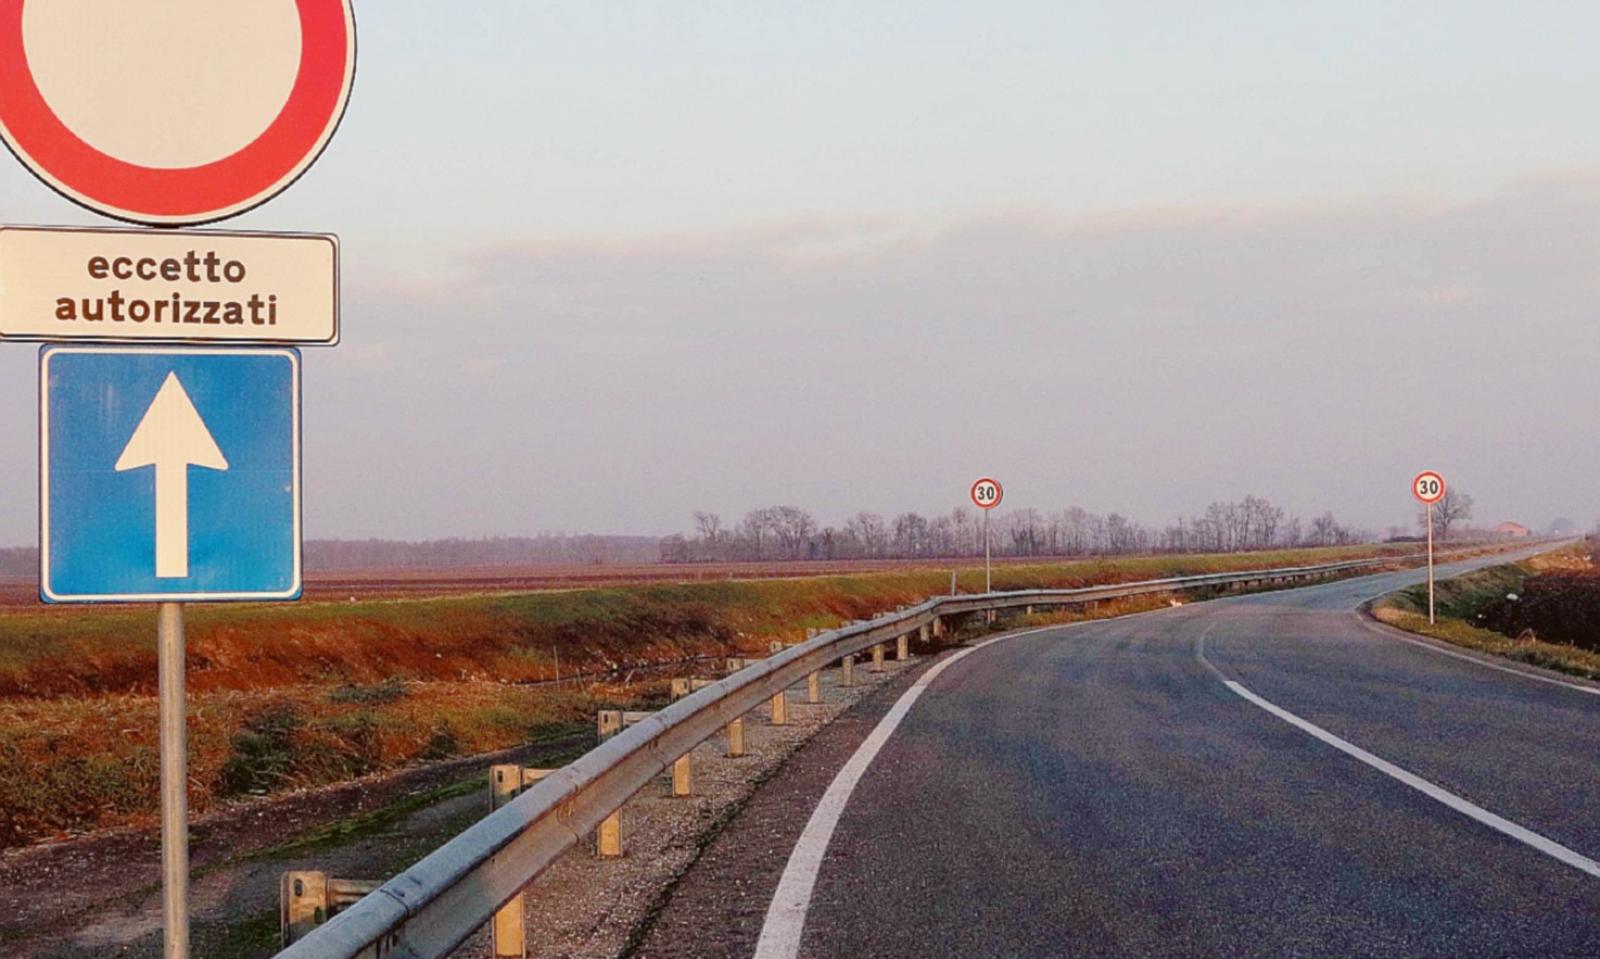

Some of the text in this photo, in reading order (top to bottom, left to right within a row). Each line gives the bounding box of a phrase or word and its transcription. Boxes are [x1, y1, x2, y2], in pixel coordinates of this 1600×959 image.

[87, 250, 246, 283] eccetto
[55, 291, 277, 325] autorizzati
[977, 486, 995, 500] 30
[1420, 480, 1439, 495] 30
